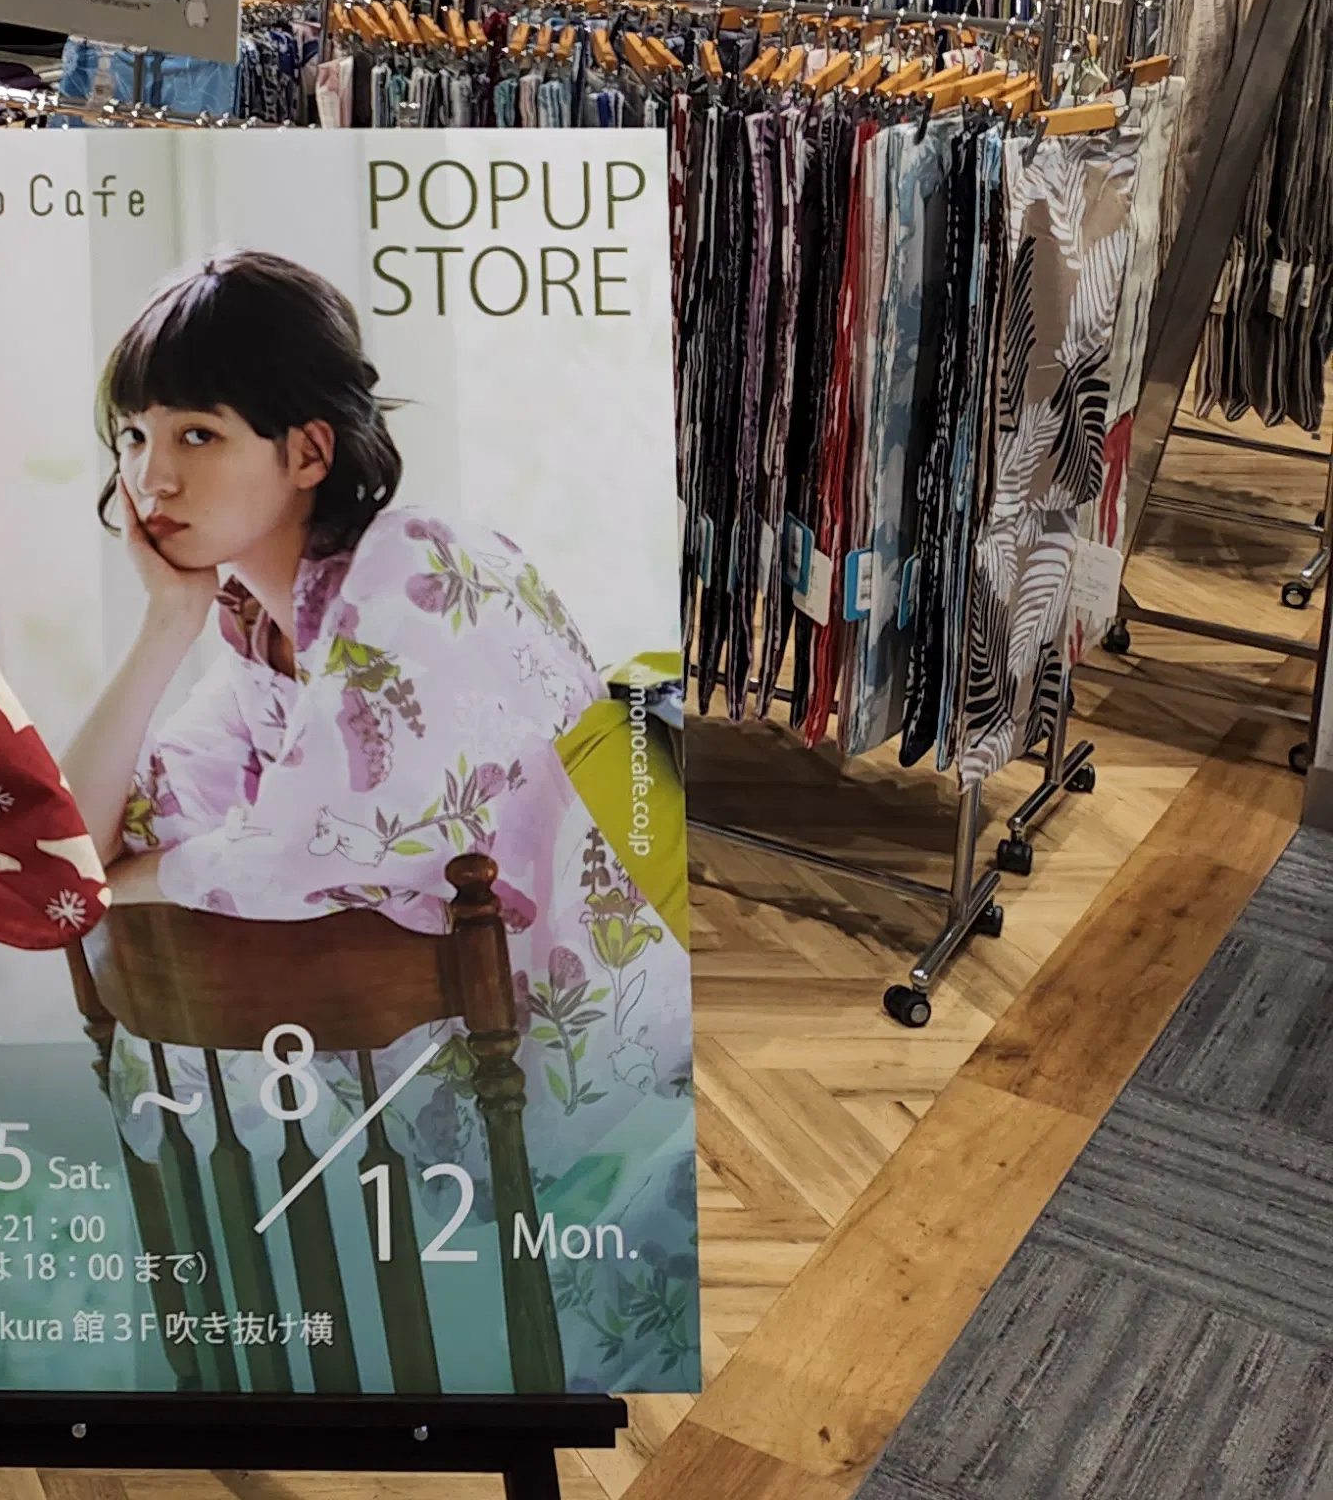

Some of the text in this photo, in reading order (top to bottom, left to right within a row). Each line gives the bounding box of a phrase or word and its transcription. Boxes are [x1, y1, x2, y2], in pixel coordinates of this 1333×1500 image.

[29, 173, 146, 218] Cafe
[368, 159, 647, 231] POPUP
[371, 245, 632, 317] STORE
[48, 1156, 111, 1190] Sat.
[512, 1211, 640, 1260] Mon.
